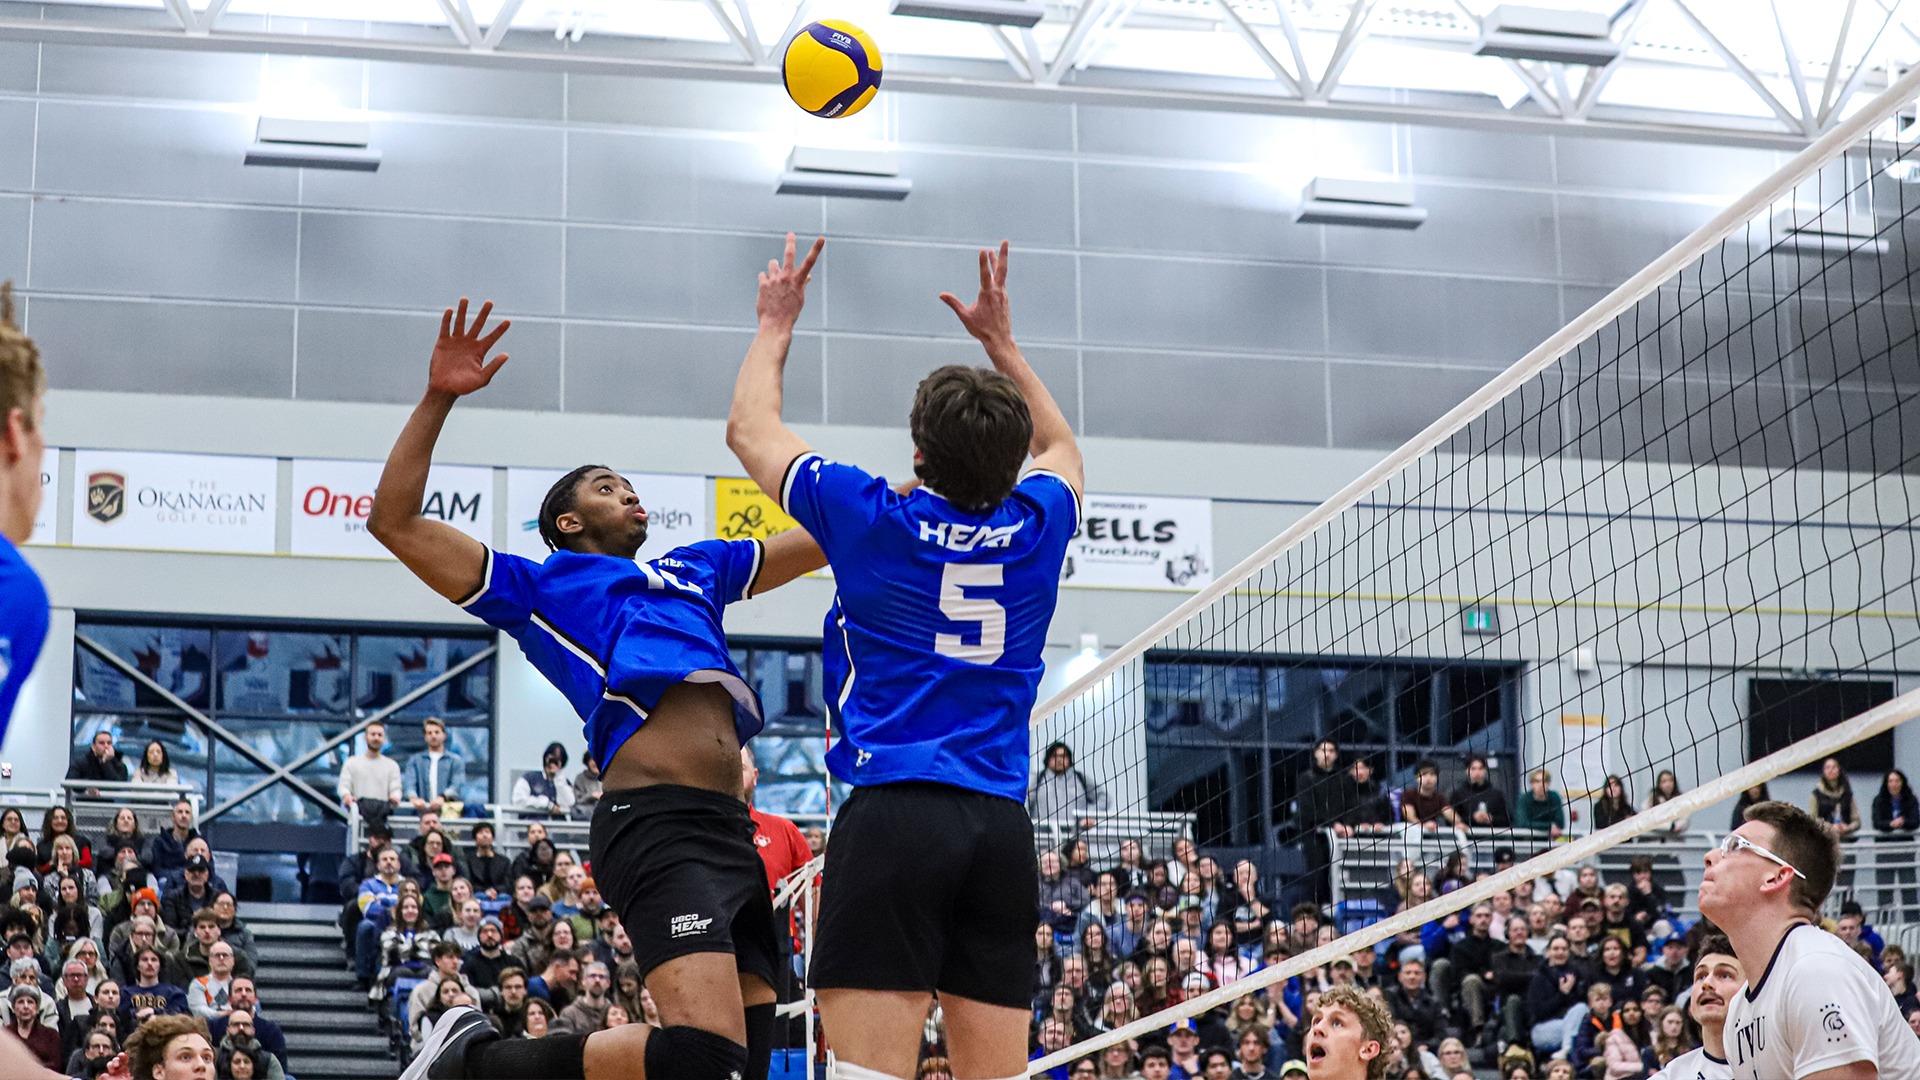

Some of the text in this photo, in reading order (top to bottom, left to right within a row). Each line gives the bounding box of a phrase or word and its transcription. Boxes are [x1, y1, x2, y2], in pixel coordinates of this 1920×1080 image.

[831, 32, 852, 45] FIVB
[189, 479, 218, 491] THE
[138, 486, 266, 512] OKANAGAN
[156, 511, 248, 526] GOLF CLUB
[918, 519, 1025, 552] HEAT
[1078, 544, 1161, 561] Trucking
[934, 562, 1007, 666] 5
[671, 913, 699, 924] UBCO
[671, 917, 713, 935] HEAT
